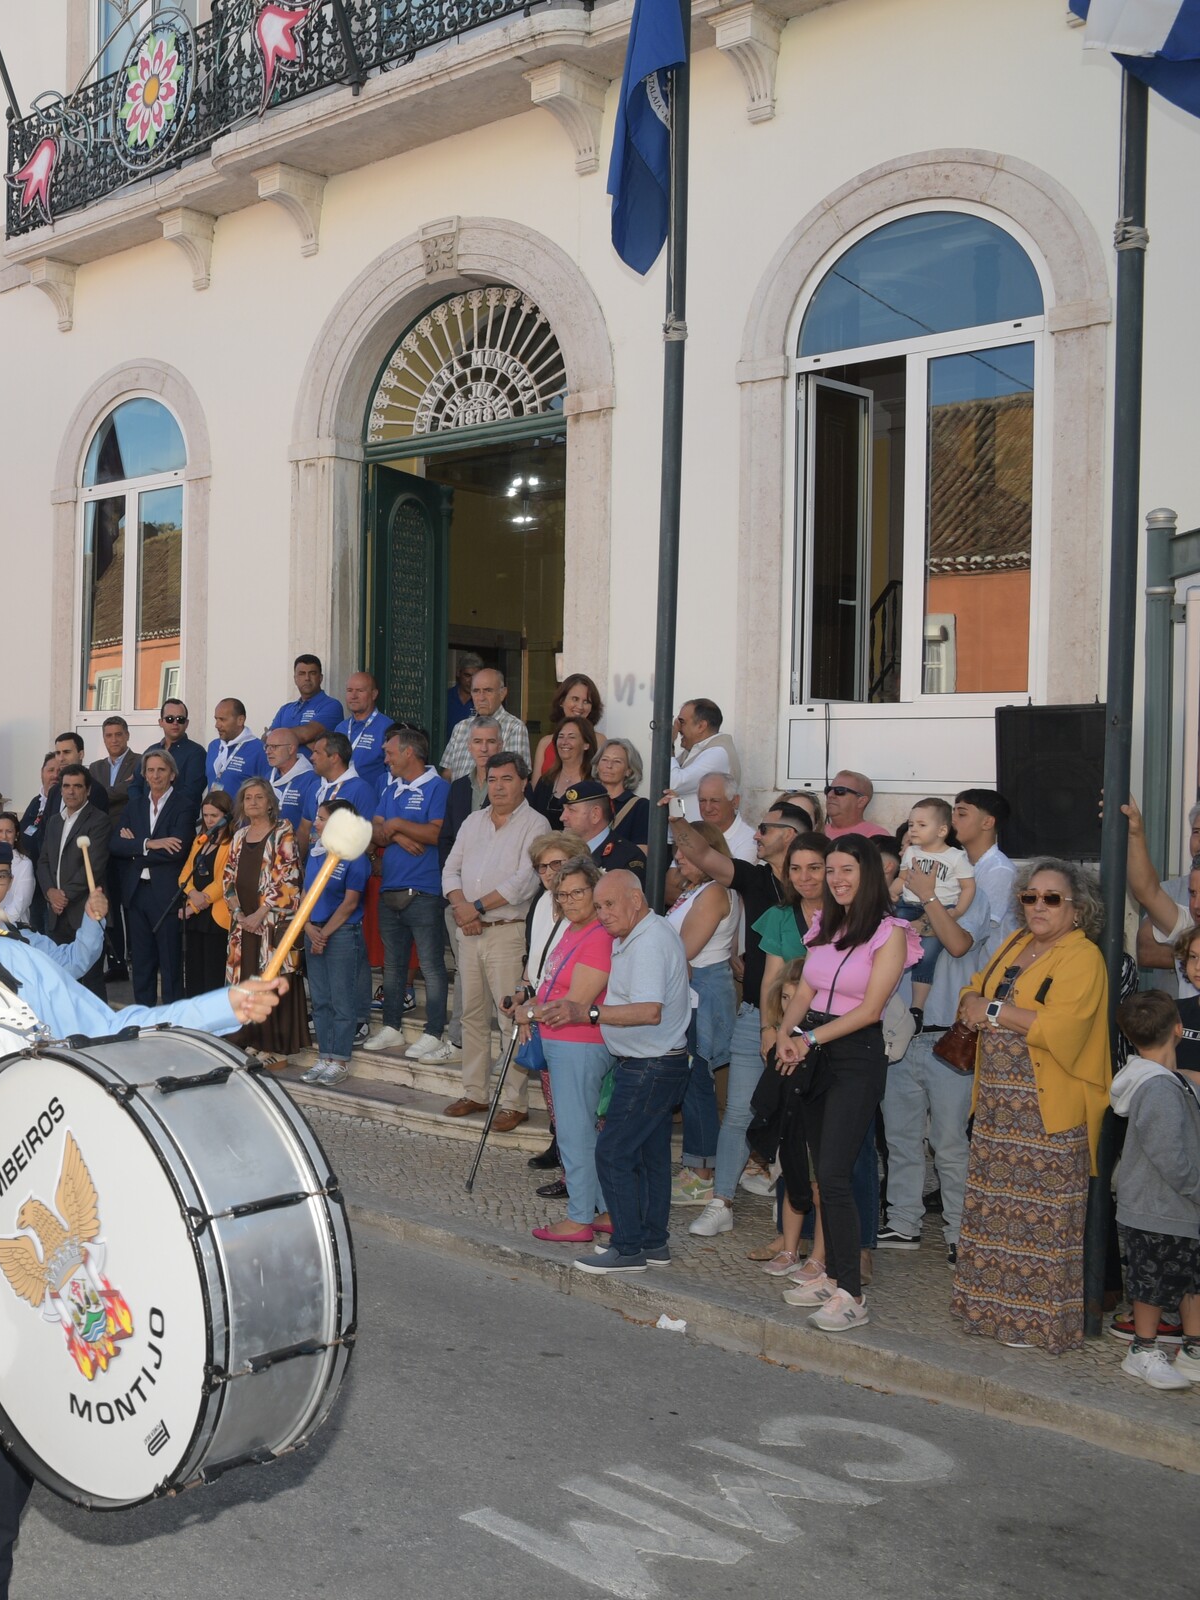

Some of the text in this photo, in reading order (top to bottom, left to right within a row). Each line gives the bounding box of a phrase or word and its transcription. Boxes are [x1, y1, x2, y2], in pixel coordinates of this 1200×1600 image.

[415, 350, 539, 433] CAMARA MUNICIPAL
[446, 391, 467, 418] DE
[468, 384, 511, 420] JULHO
[457, 407, 494, 426] 1878
[69, 1306, 165, 1425] MONTIJO
